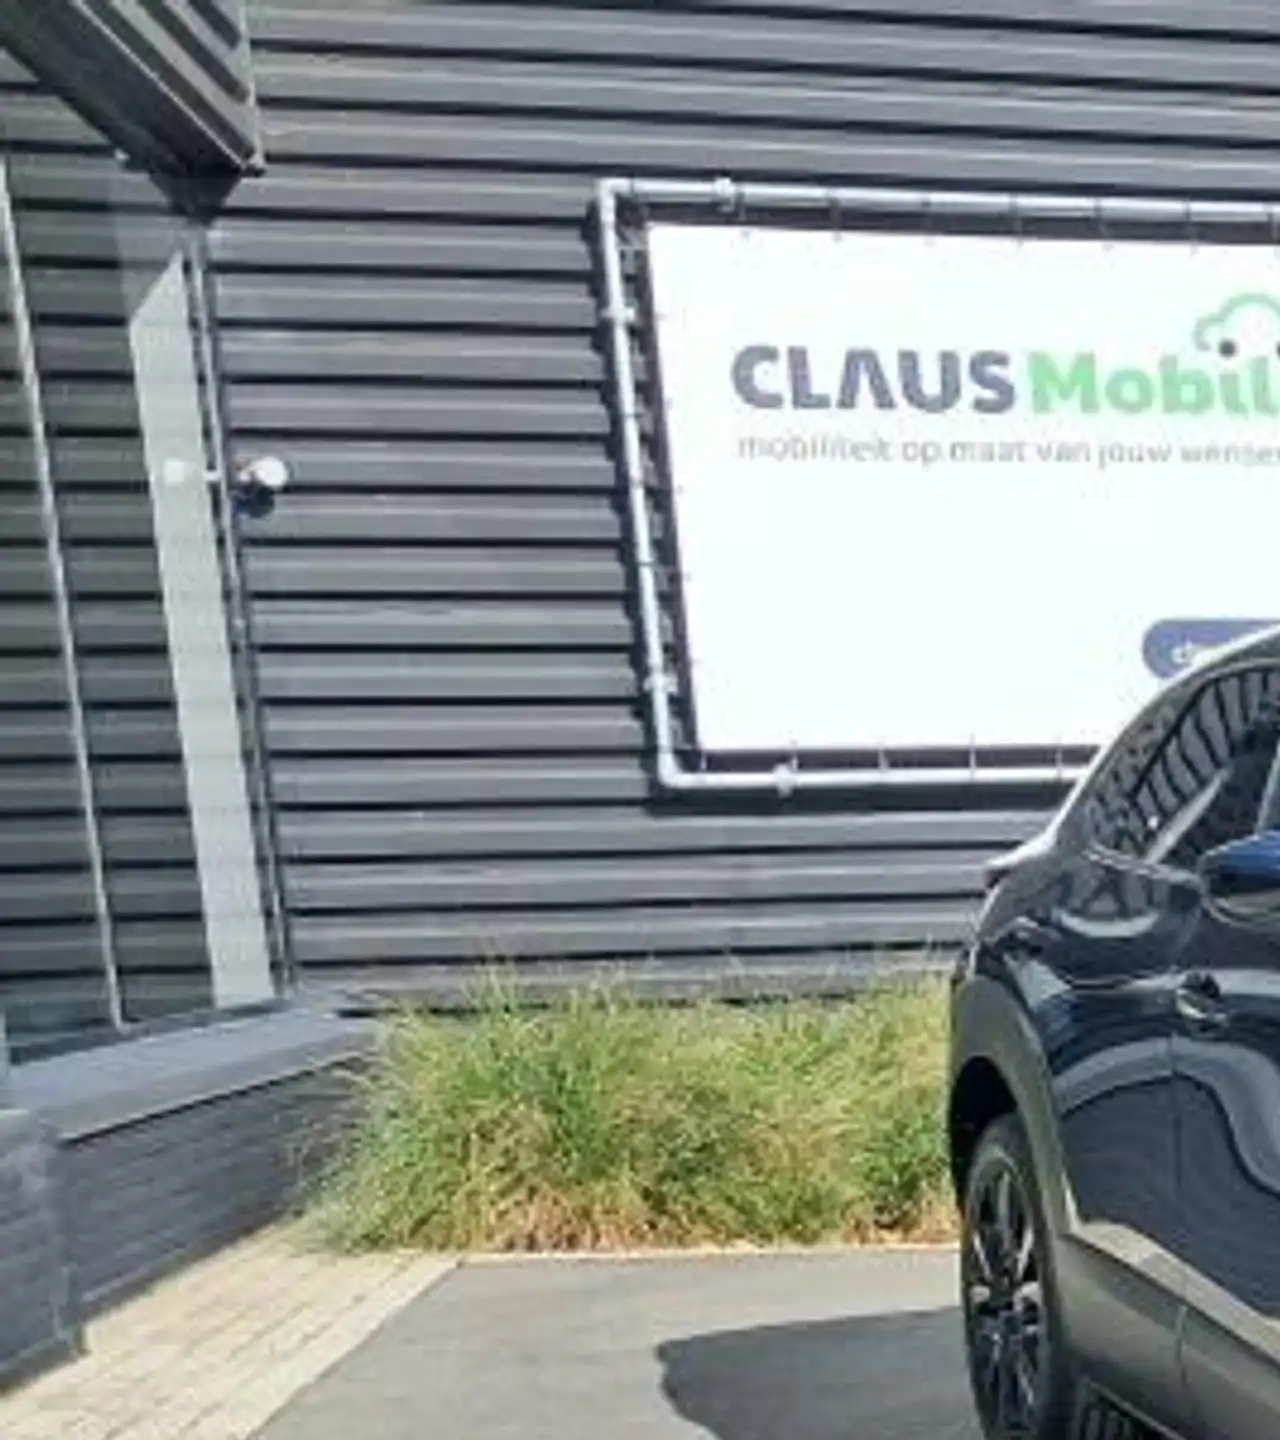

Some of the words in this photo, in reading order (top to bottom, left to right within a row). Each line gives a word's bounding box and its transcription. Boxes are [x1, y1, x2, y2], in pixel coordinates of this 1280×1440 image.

[731, 345, 1016, 414] CLAUS
[738, 432, 893, 462] mobiliteit
[901, 440, 942, 467] op
[950, 440, 1026, 462] maat
[1036, 443, 1092, 464] van
[1097, 443, 1172, 470] jouw
